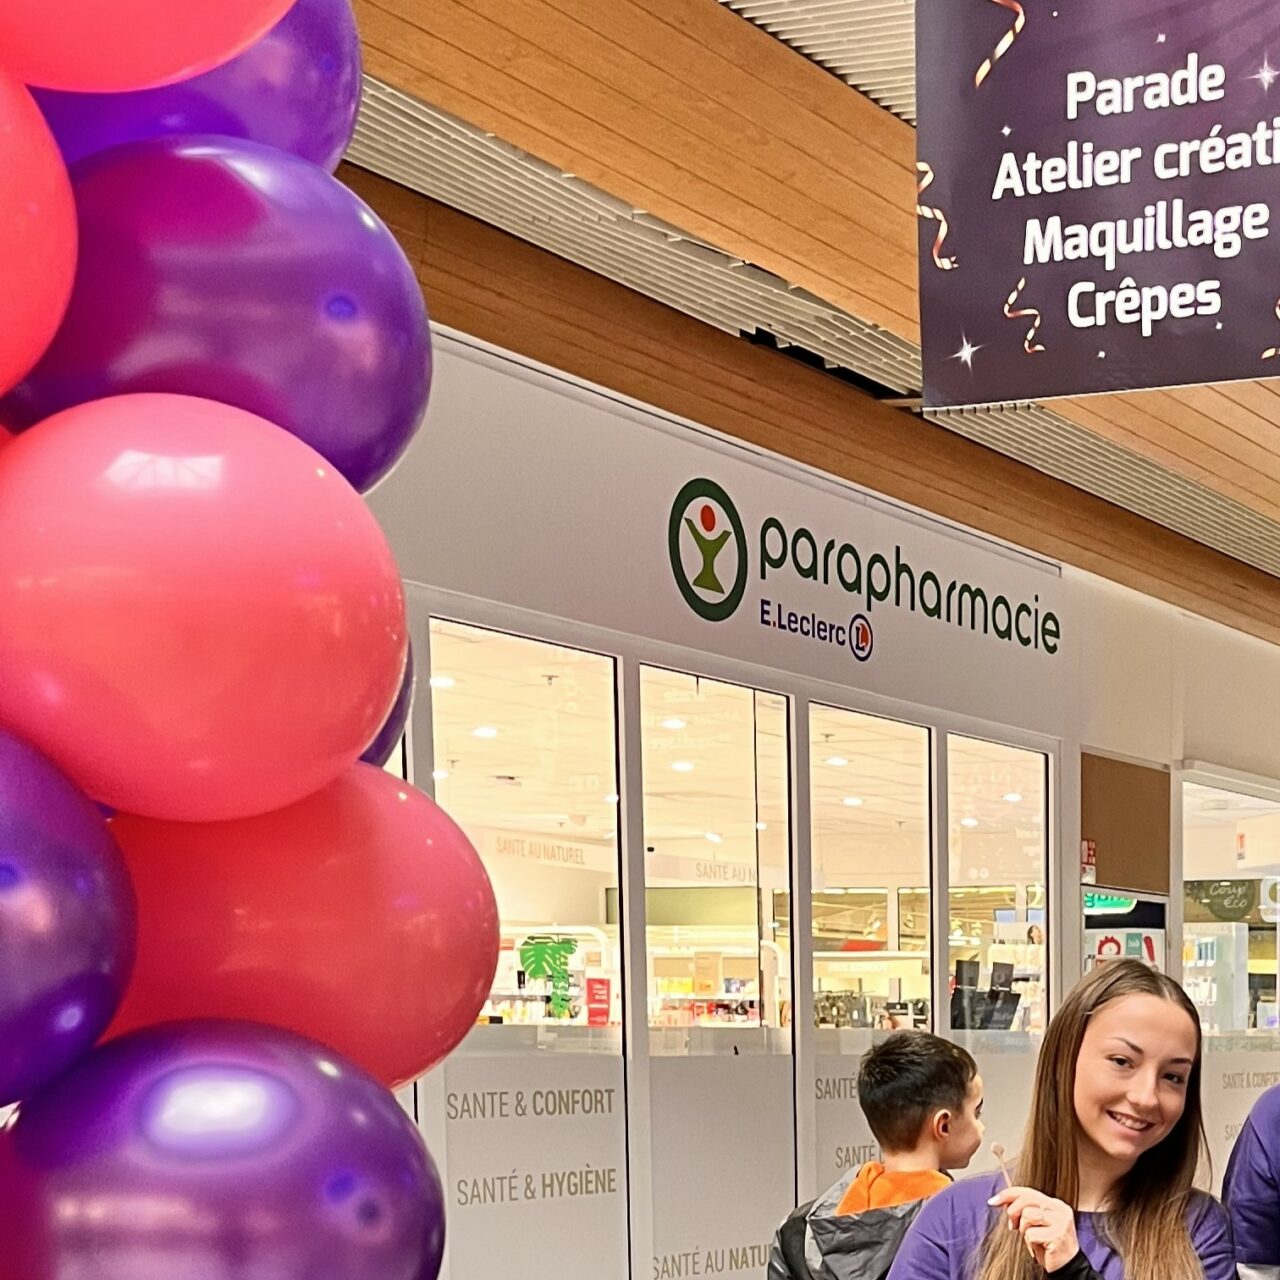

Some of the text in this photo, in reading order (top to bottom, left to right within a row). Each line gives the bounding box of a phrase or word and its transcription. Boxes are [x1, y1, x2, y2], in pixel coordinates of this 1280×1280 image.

[1066, 52, 1226, 121] Parade
[991, 141, 1142, 201] Atelier
[1022, 198, 1270, 272] Maquillage
[1066, 276, 1222, 338] Crêpes
[759, 516, 1061, 654] parapharmacie
[760, 598, 846, 646] E.Leclerc
[447, 1088, 615, 1120] SANTE & CONFORT
[815, 1072, 857, 1100] SANTÉ
[457, 1163, 617, 1206] SANTÉ & HYGIÈNE
[652, 1243, 772, 1280] SANTÉ AU NATU
